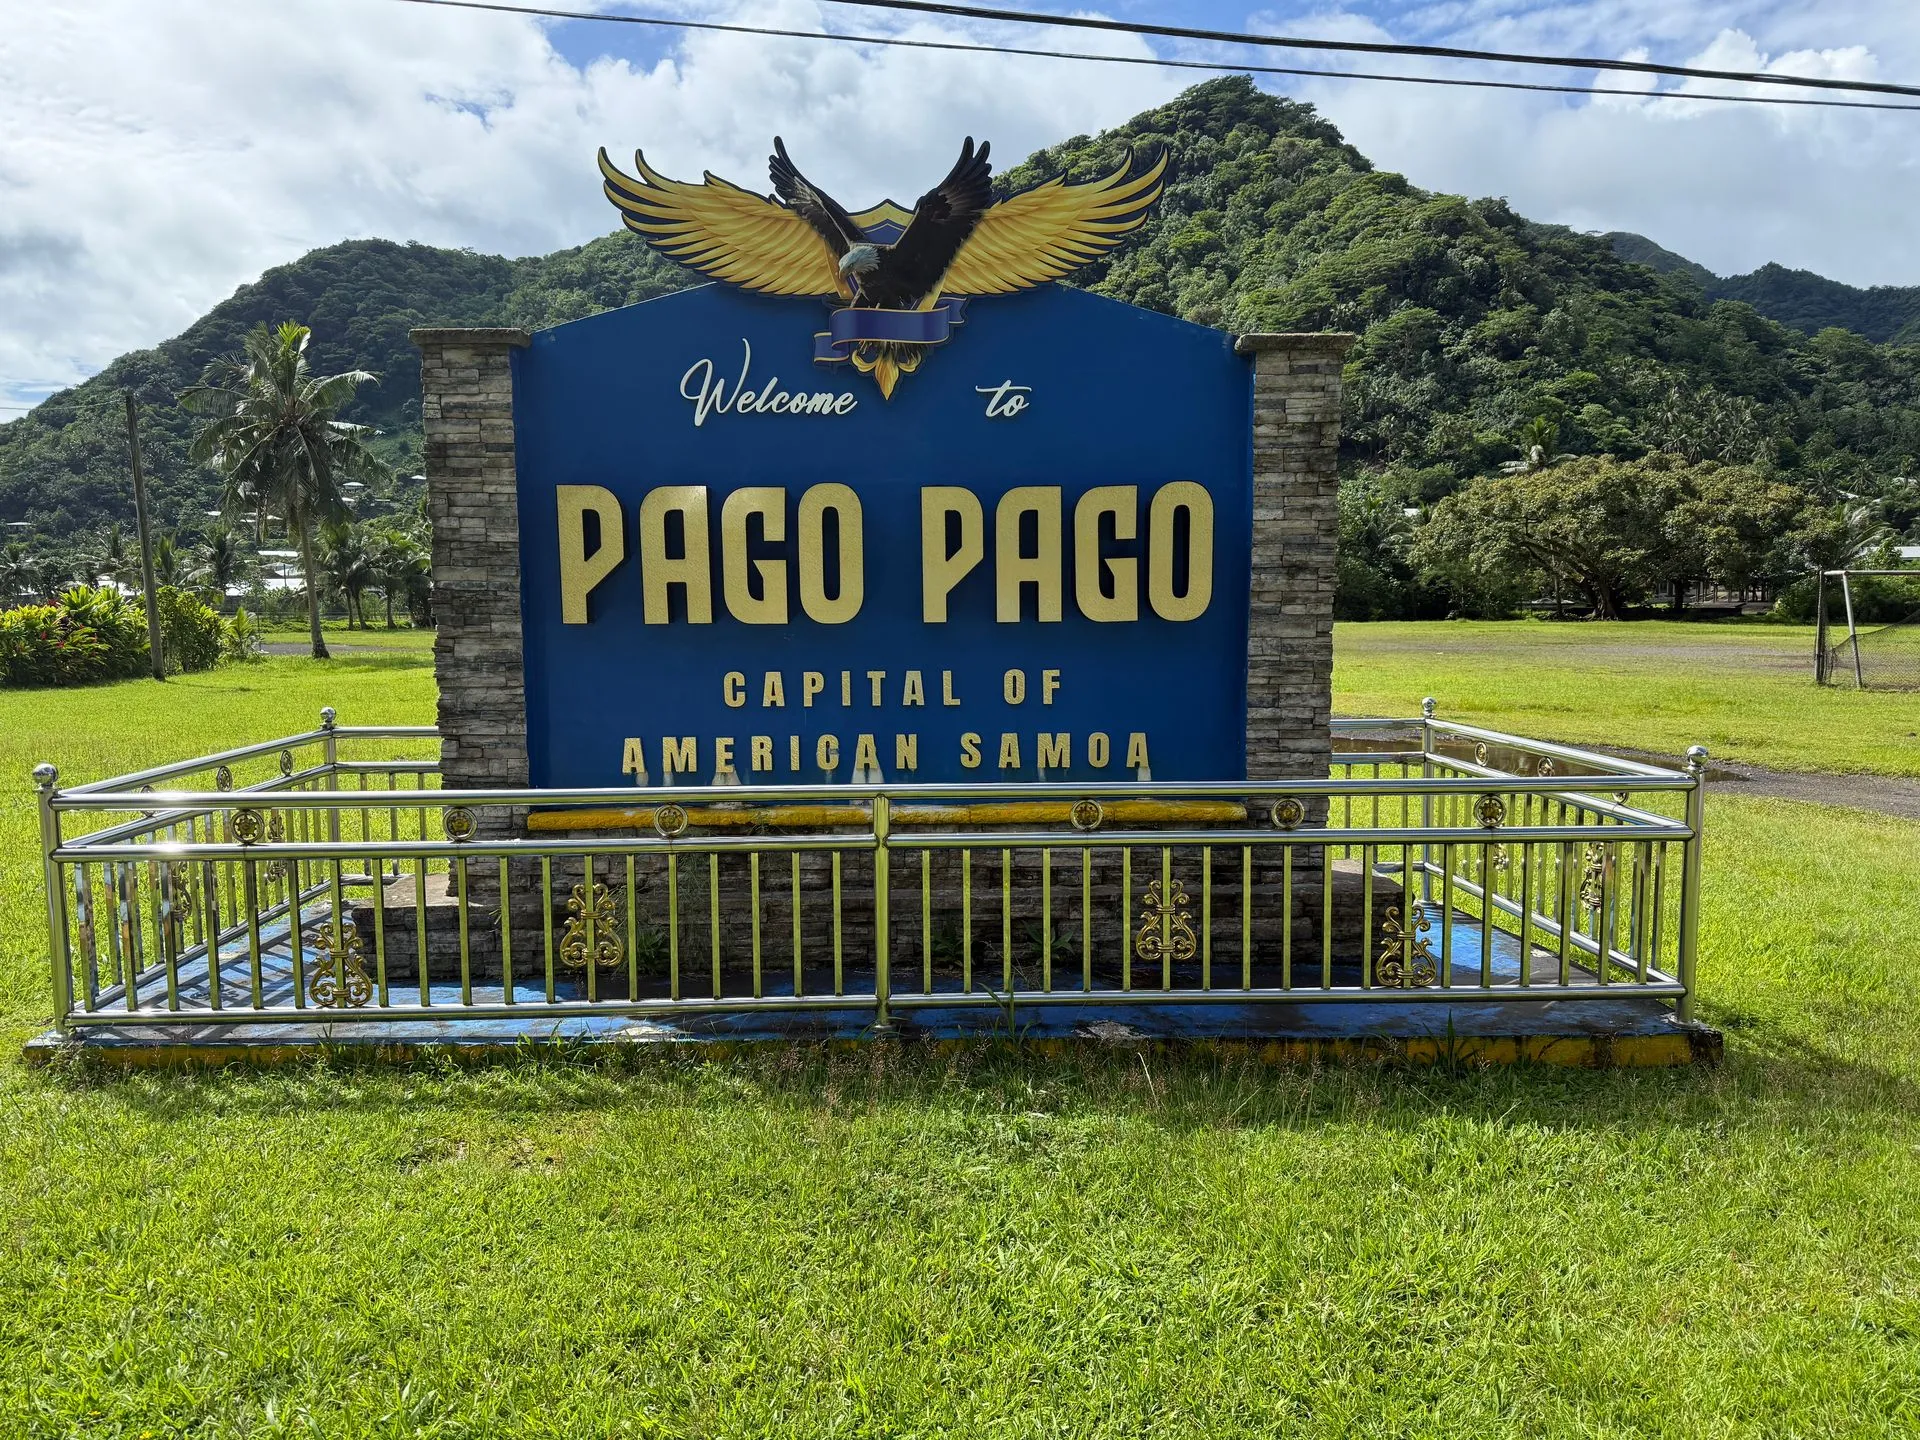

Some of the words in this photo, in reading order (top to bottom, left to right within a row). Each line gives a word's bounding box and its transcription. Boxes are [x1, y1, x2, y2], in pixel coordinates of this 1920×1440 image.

[680, 338, 857, 427] Welcome
[975, 379, 1032, 418] to
[556, 483, 864, 625] PAGO
[920, 481, 1214, 623] PAGO
[723, 670, 961, 708] CAPITAL
[1003, 669, 1060, 706] OF
[622, 733, 918, 773] AMERICAN
[960, 732, 1150, 769] SAMOA
